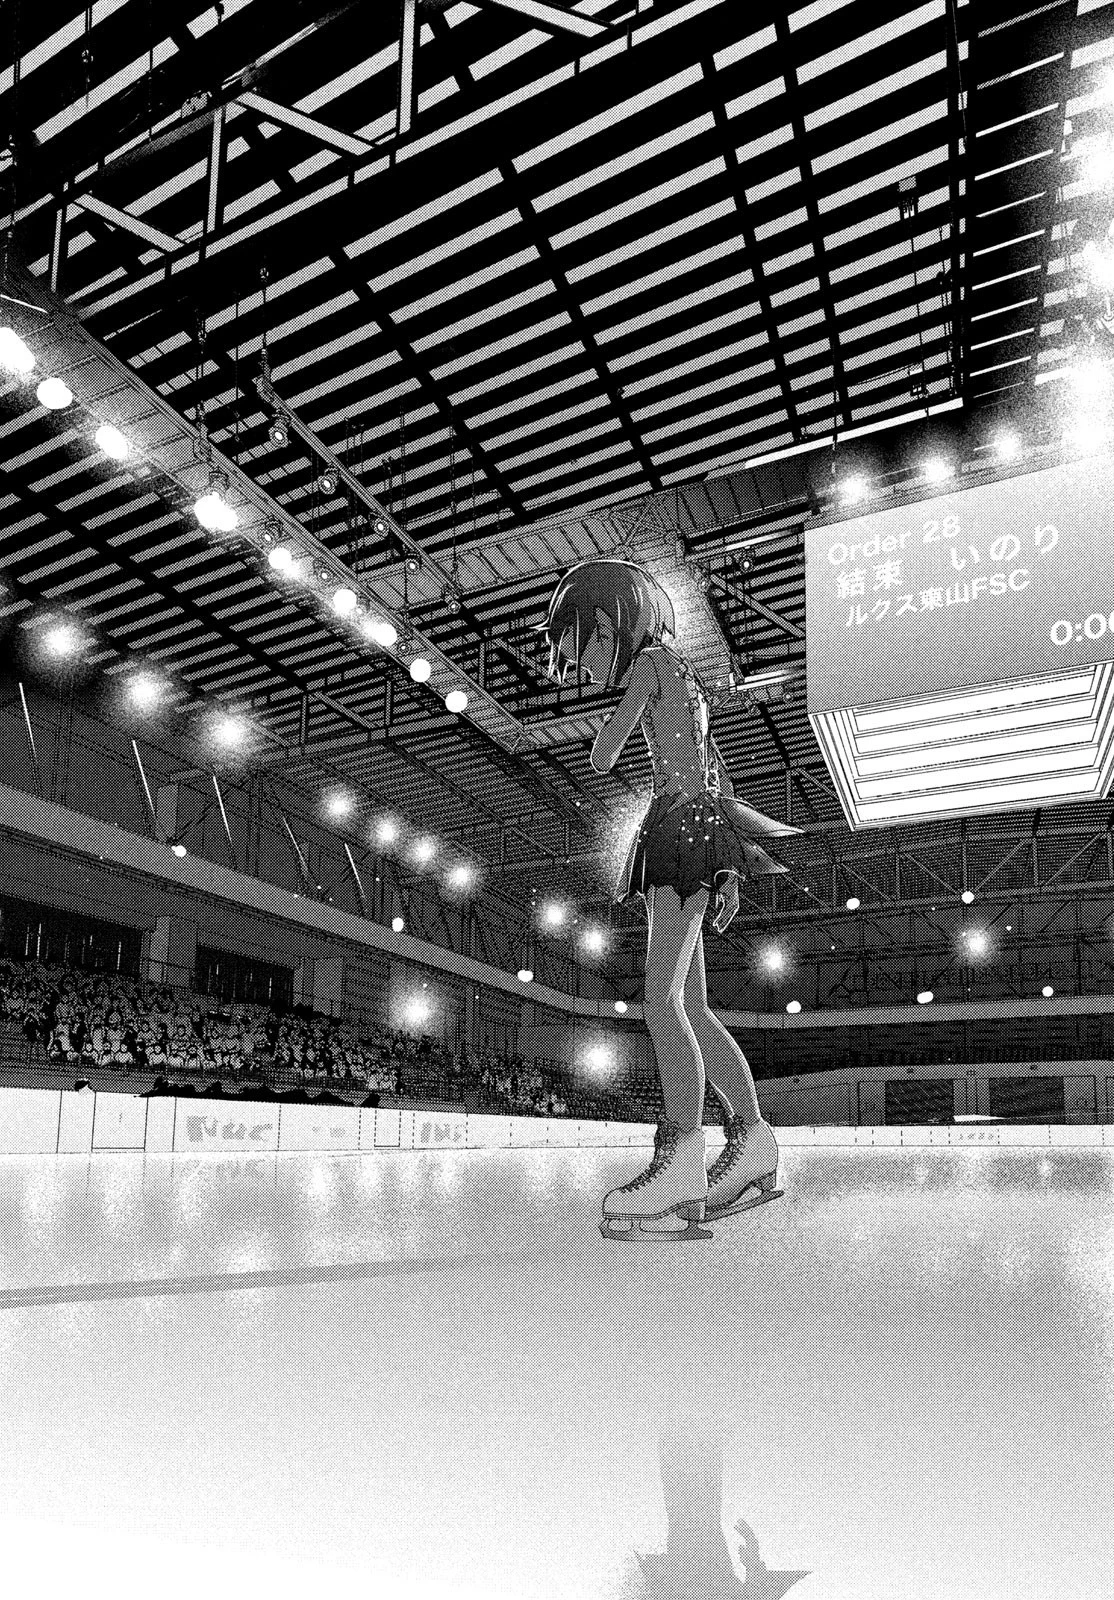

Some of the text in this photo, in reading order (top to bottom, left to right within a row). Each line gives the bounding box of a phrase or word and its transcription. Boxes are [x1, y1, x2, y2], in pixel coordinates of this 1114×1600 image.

[827, 514, 961, 565] Order 28
[836, 523, 1059, 599] 結束 いのり
[845, 568, 1031, 627] ルクス東山FSC
[1050, 611, 1114, 645] 0:0
